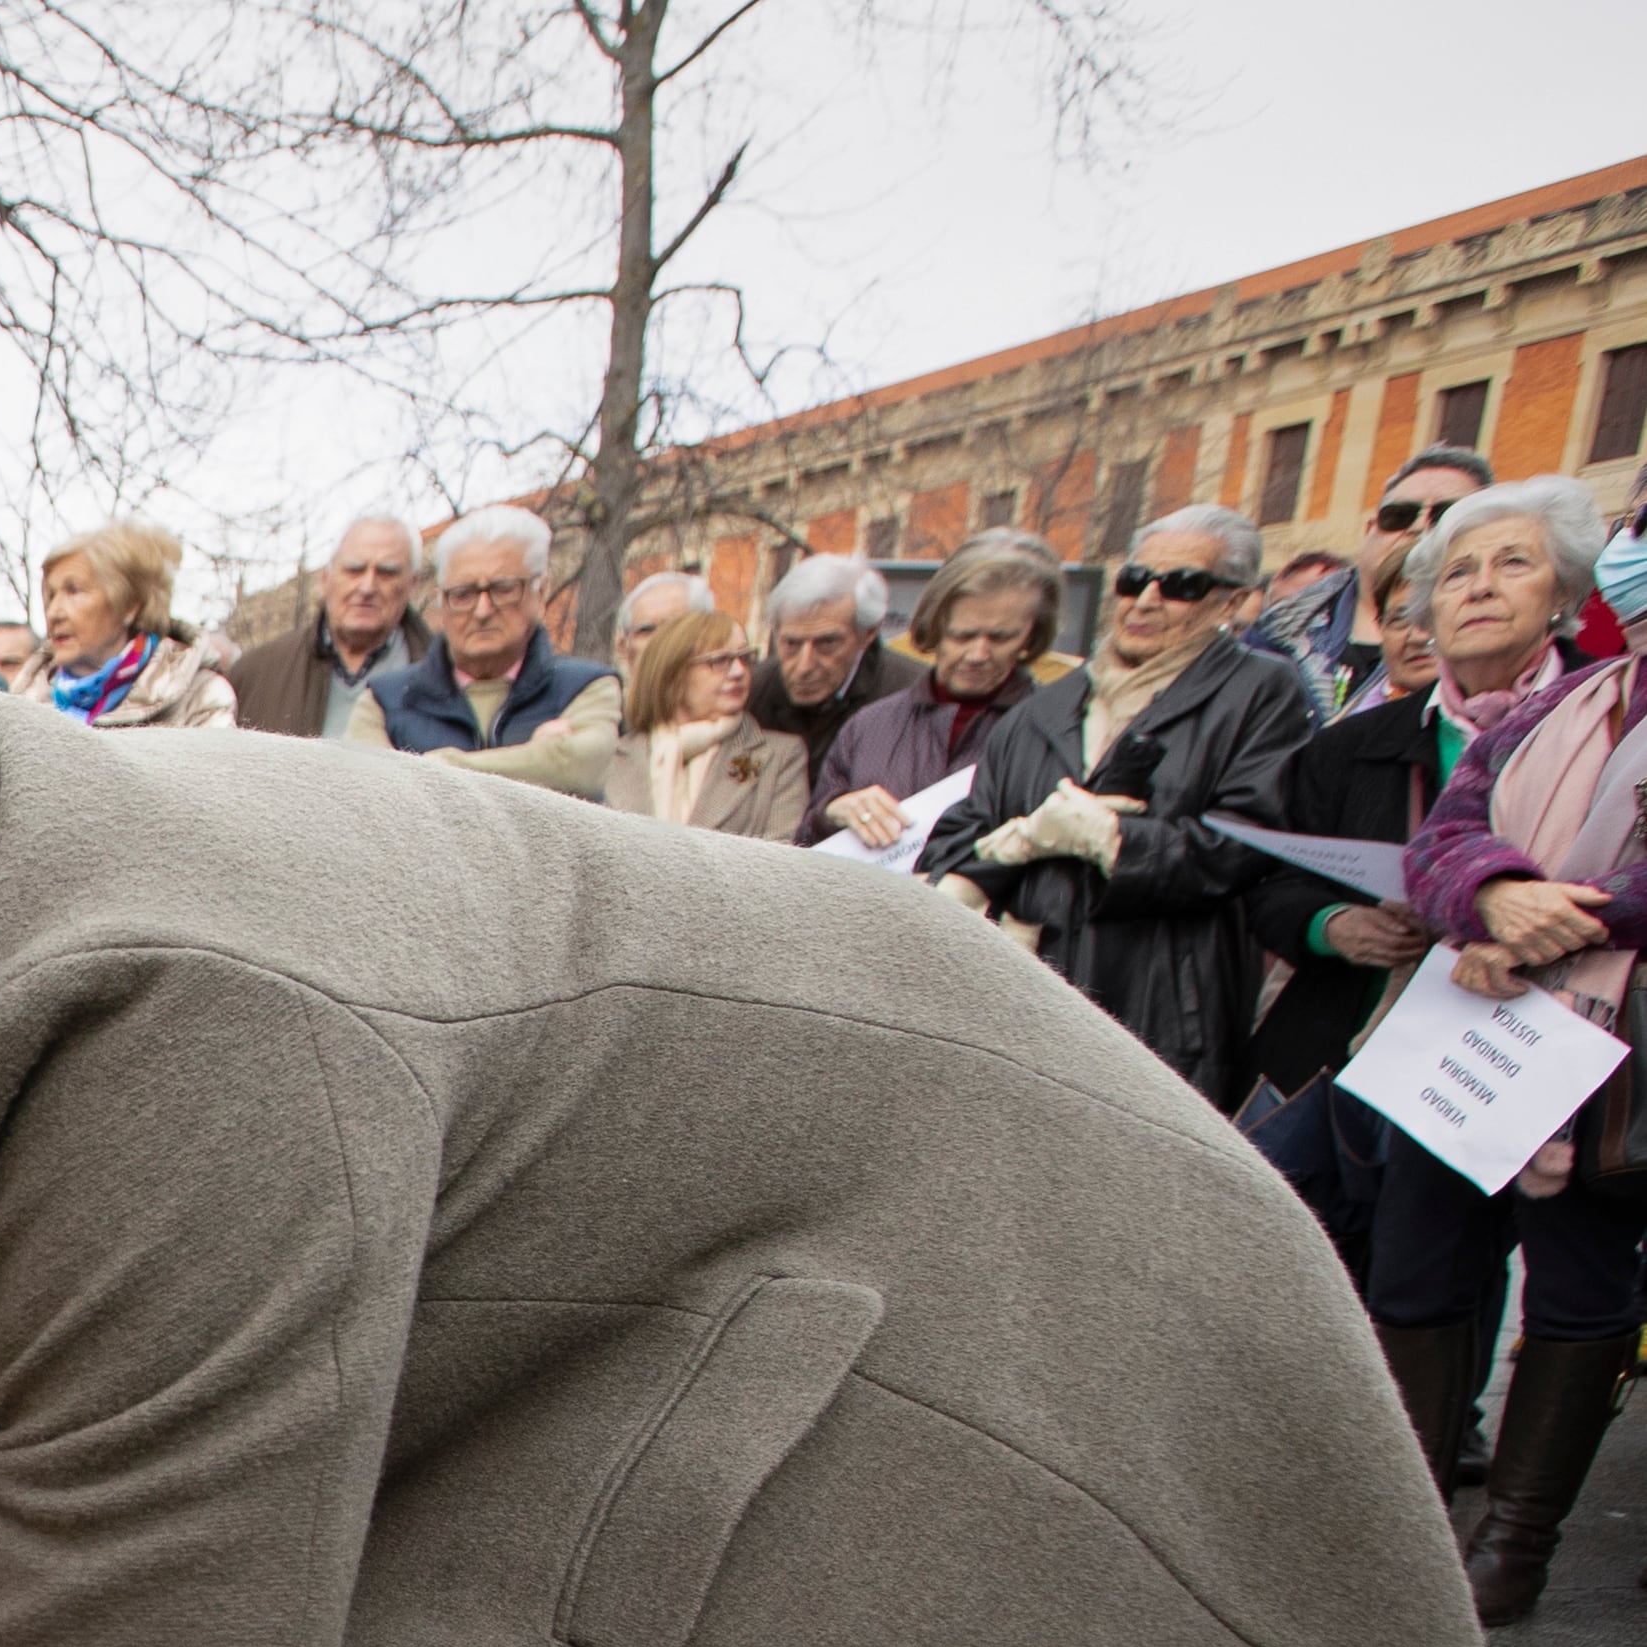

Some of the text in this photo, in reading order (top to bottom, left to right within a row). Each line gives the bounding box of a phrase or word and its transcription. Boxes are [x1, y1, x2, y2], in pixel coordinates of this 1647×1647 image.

[1491, 1003, 1542, 1047] JUSTICIA
[1463, 1029, 1522, 1078] DIGNIDAD
[1440, 1056, 1498, 1105] MEMORIA
[1420, 1088, 1467, 1128] VERDAD
